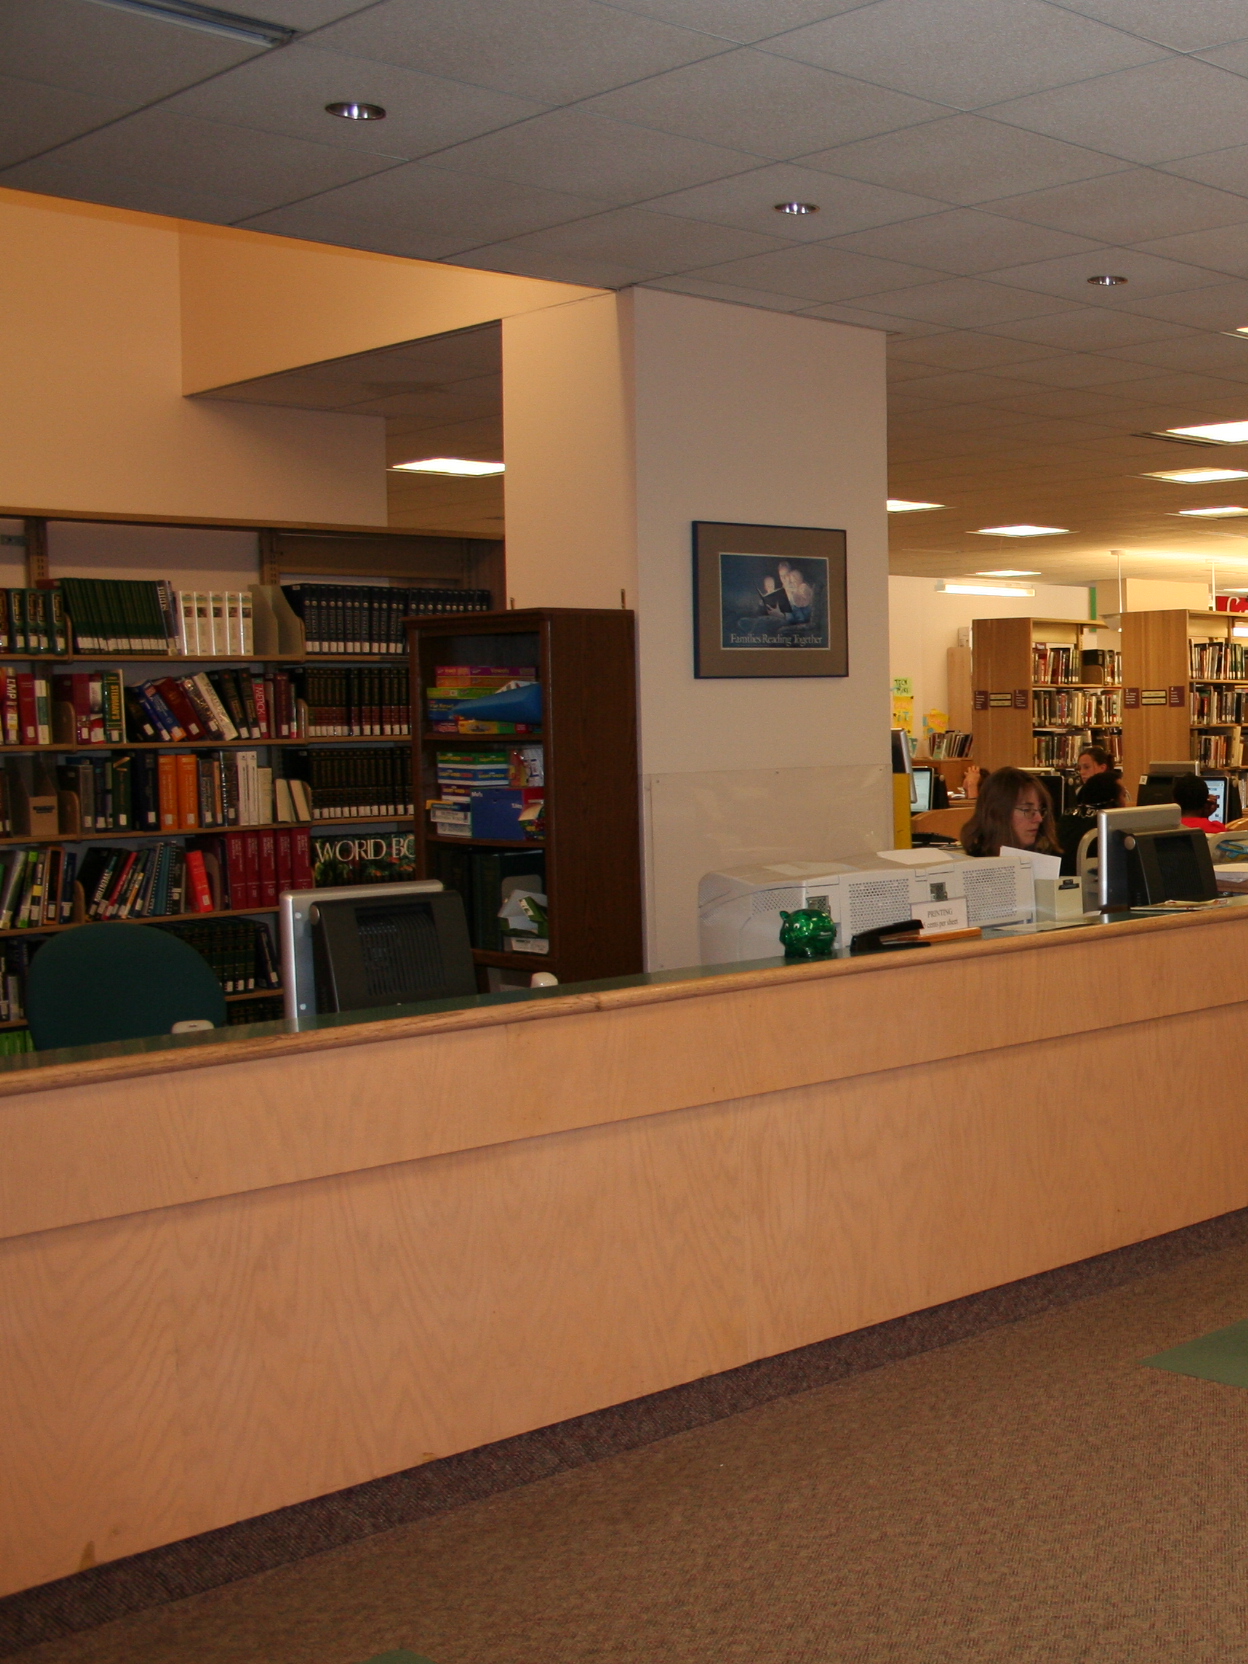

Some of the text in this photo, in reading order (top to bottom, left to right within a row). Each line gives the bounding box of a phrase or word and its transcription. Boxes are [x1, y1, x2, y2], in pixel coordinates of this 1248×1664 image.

[730, 633, 823, 647] Families Reading Together
[6, 678, 17, 705] LMP
[254, 685, 266, 715] MERCK
[315, 838, 387, 864] WORLD
[927, 908, 953, 919] PRINTING
